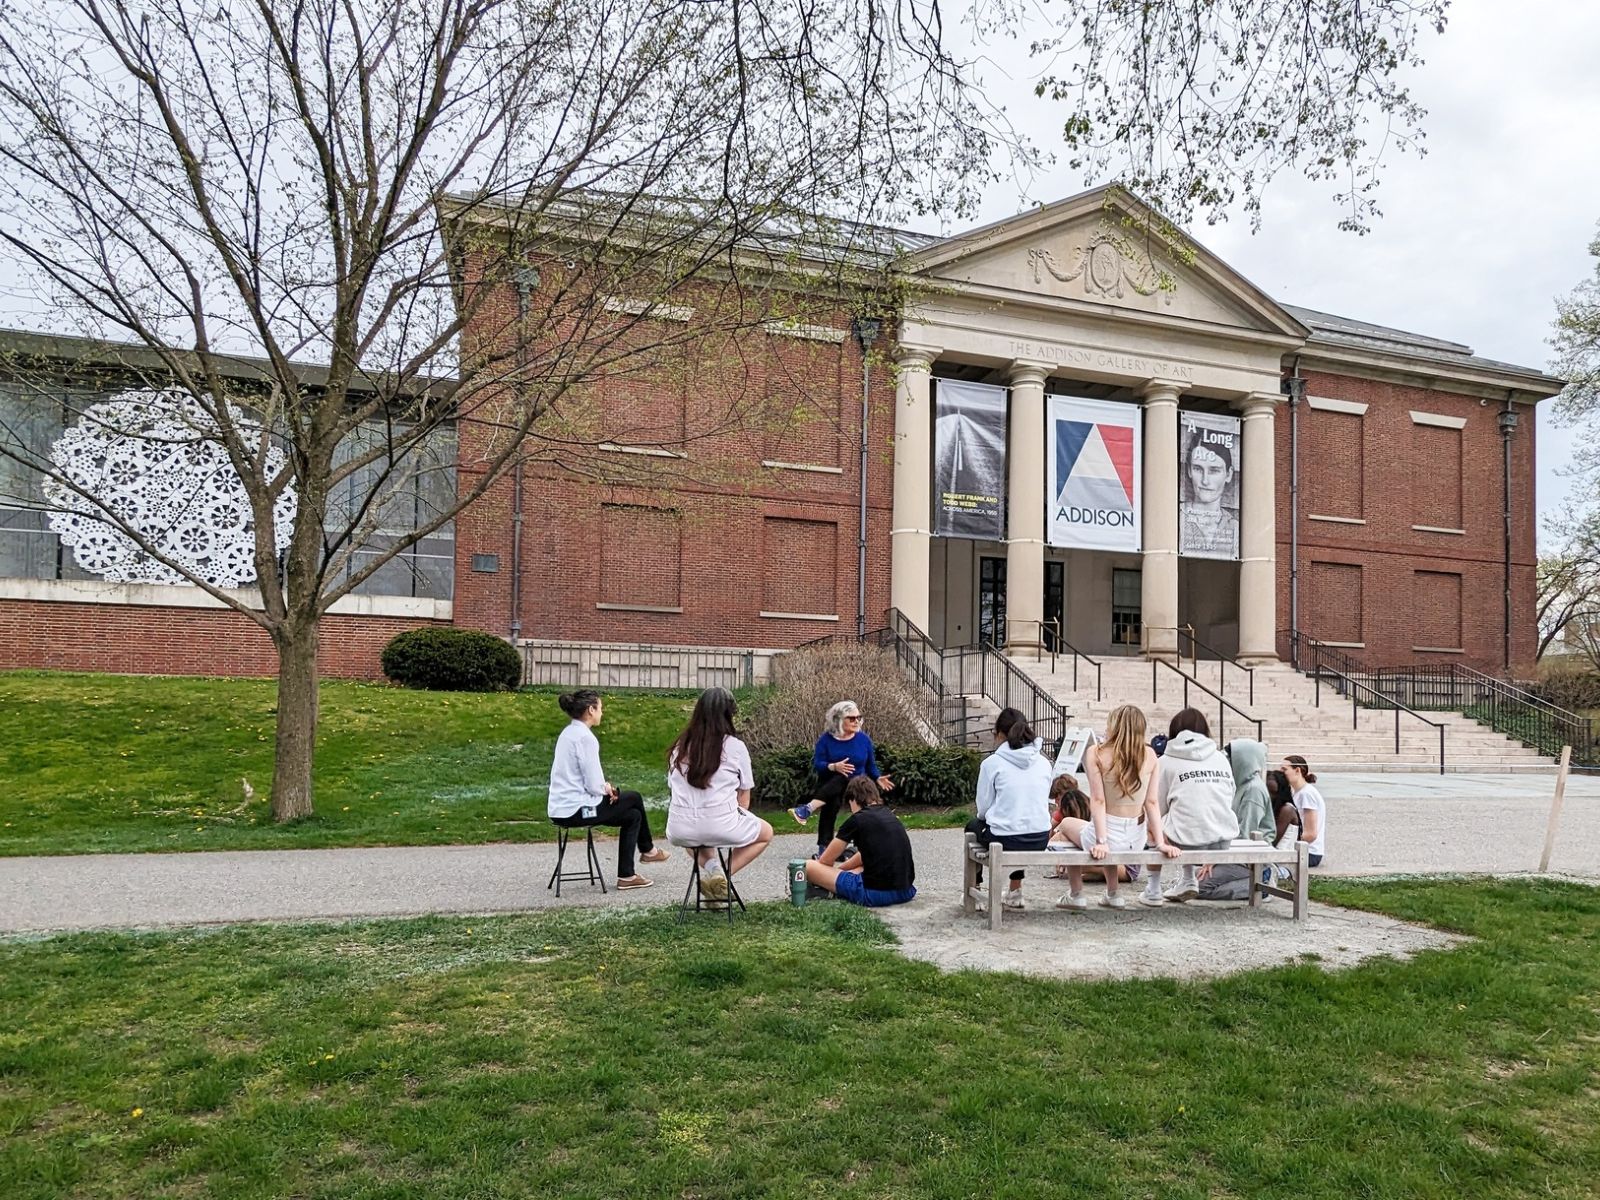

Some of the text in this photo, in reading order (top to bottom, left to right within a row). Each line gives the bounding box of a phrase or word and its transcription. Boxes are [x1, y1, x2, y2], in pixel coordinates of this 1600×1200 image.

[1009, 341, 1194, 378] THE ADDISON GALLERY OF ART
[1187, 419, 1197, 434] A
[1203, 428, 1234, 449] Long
[1193, 447, 1217, 462] Arc
[1056, 506, 1134, 527] ADDISON
[1179, 770, 1231, 783] ESSENTIALS
